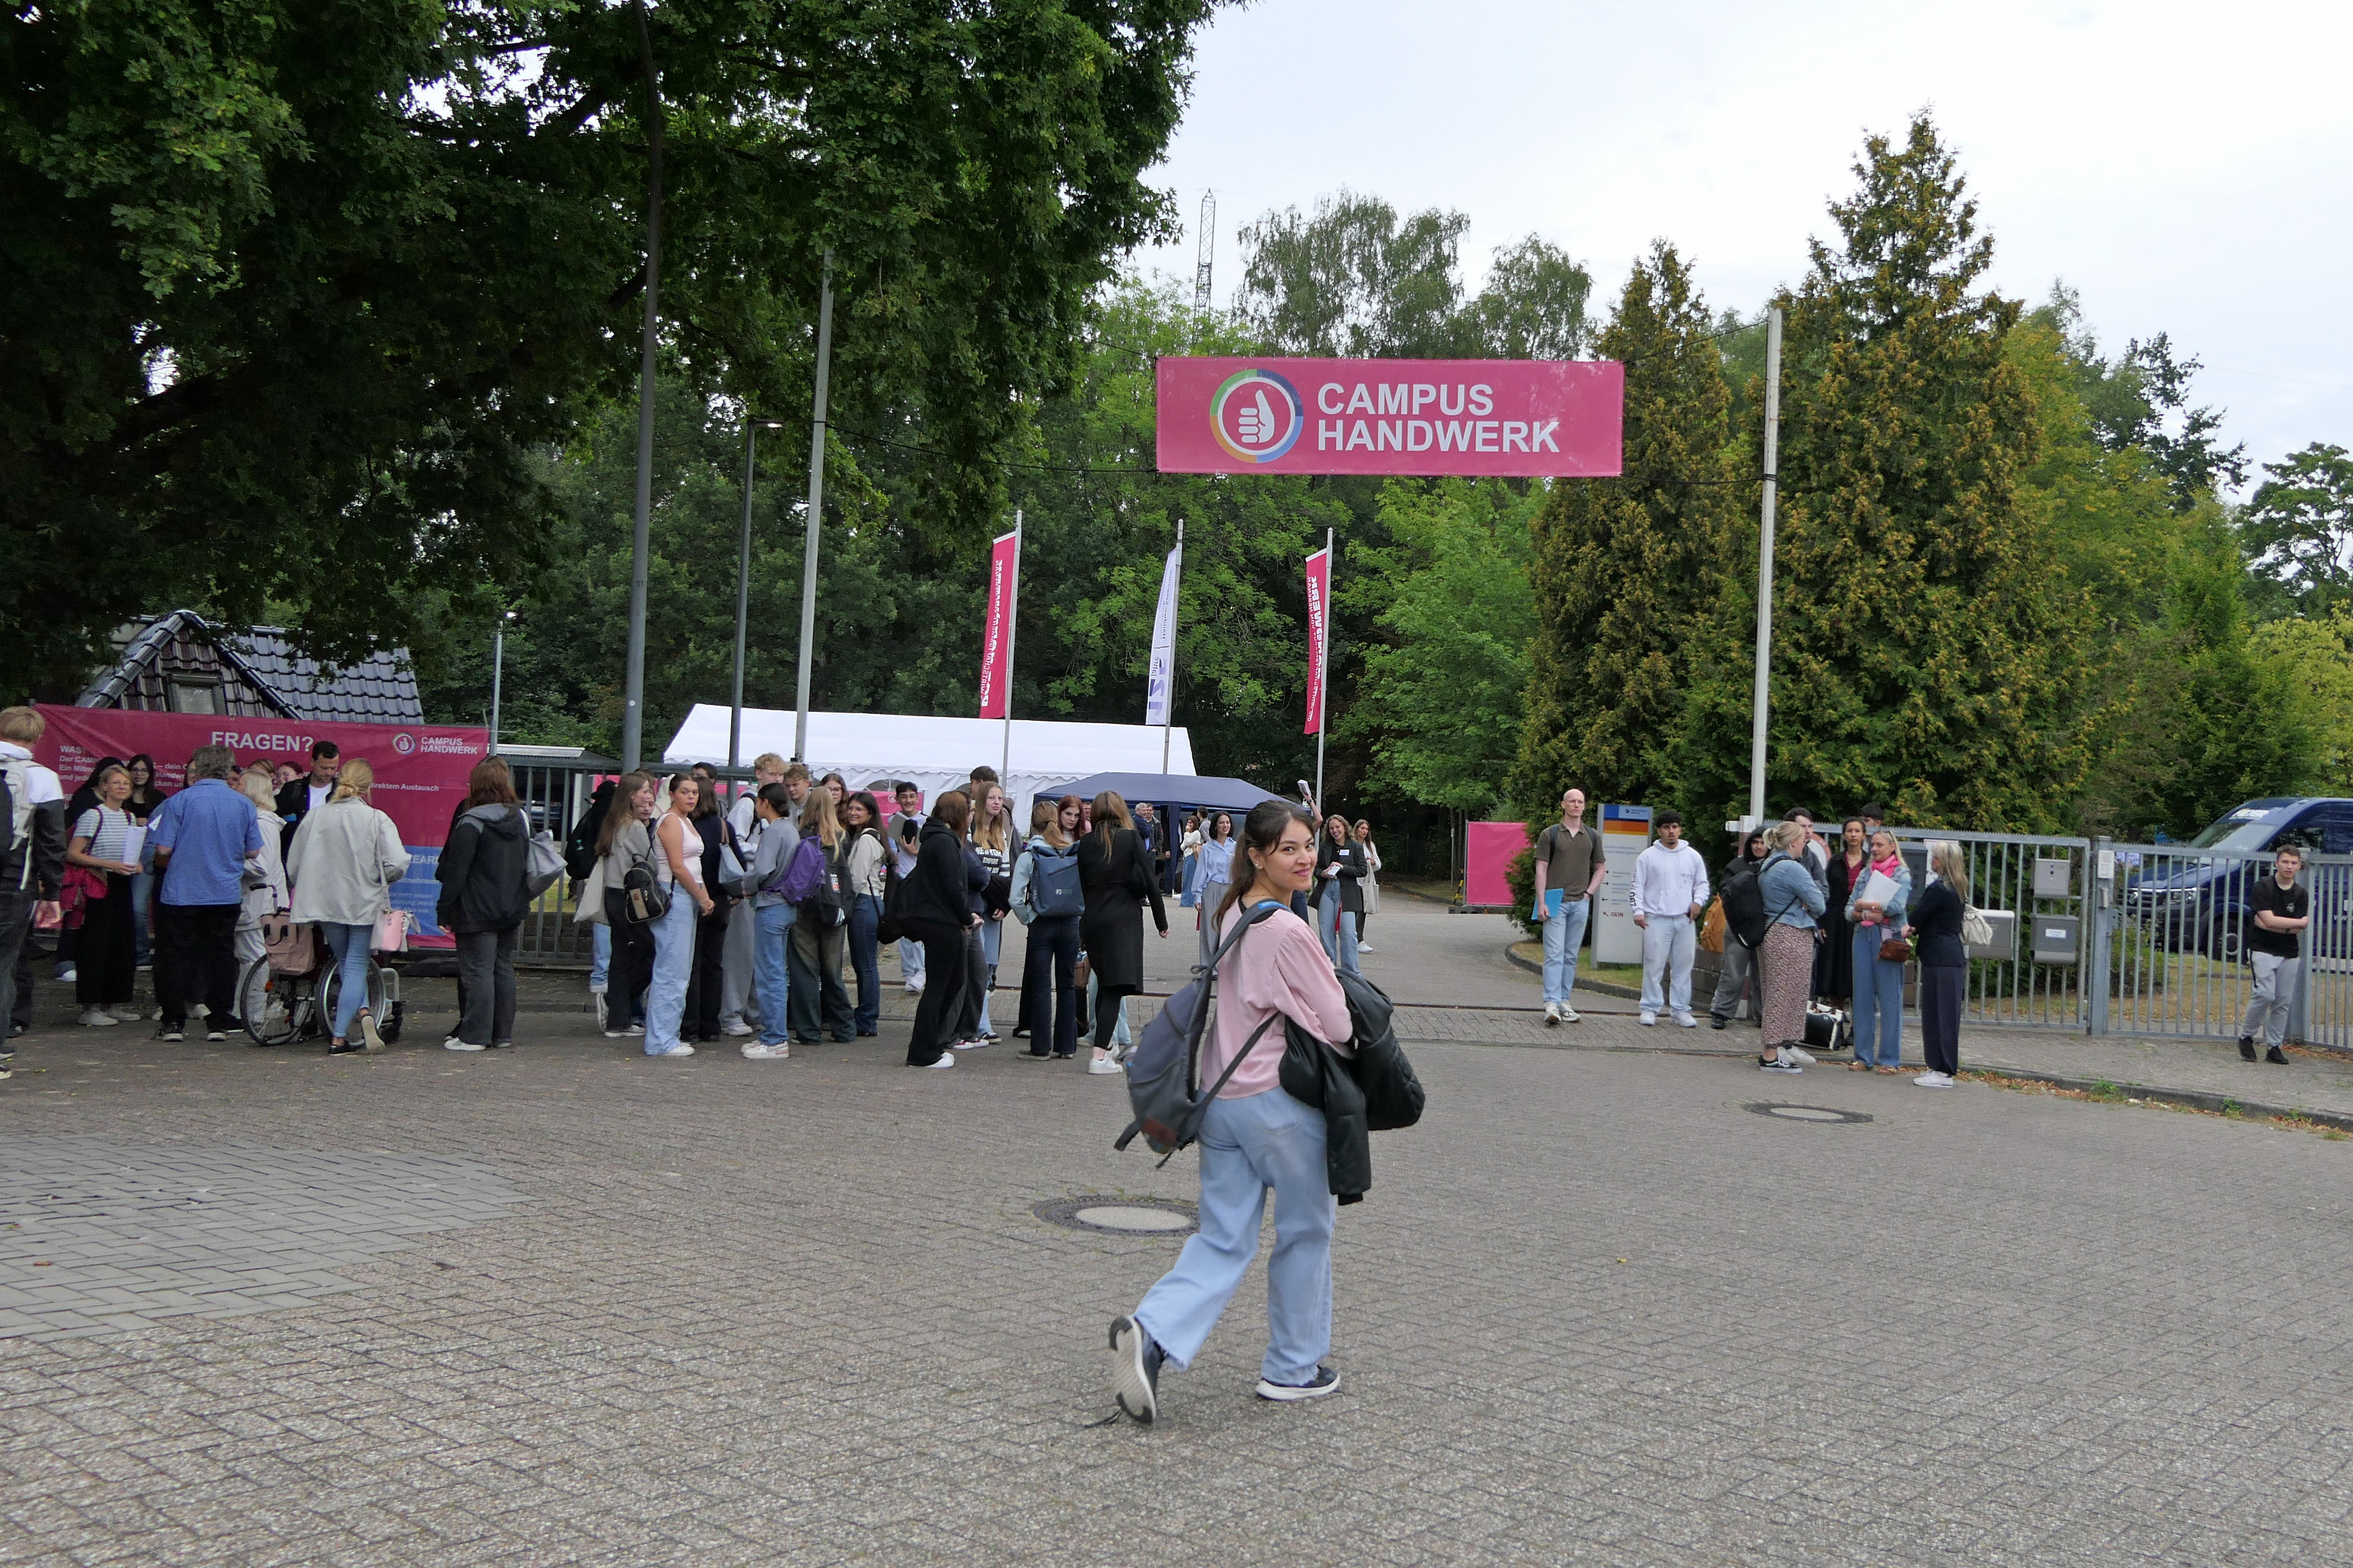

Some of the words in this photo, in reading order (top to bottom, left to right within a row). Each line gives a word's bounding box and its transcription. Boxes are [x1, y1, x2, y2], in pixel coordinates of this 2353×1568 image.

[1317, 383, 1494, 416] CAMPUS
[1317, 419, 1560, 453] HANDWERK
[212, 731, 314, 752] FRAGEN?
[421, 737, 463, 746] CAMPUS
[421, 745, 478, 754] HANDWERK
[401, 783, 439, 791] Austausch
